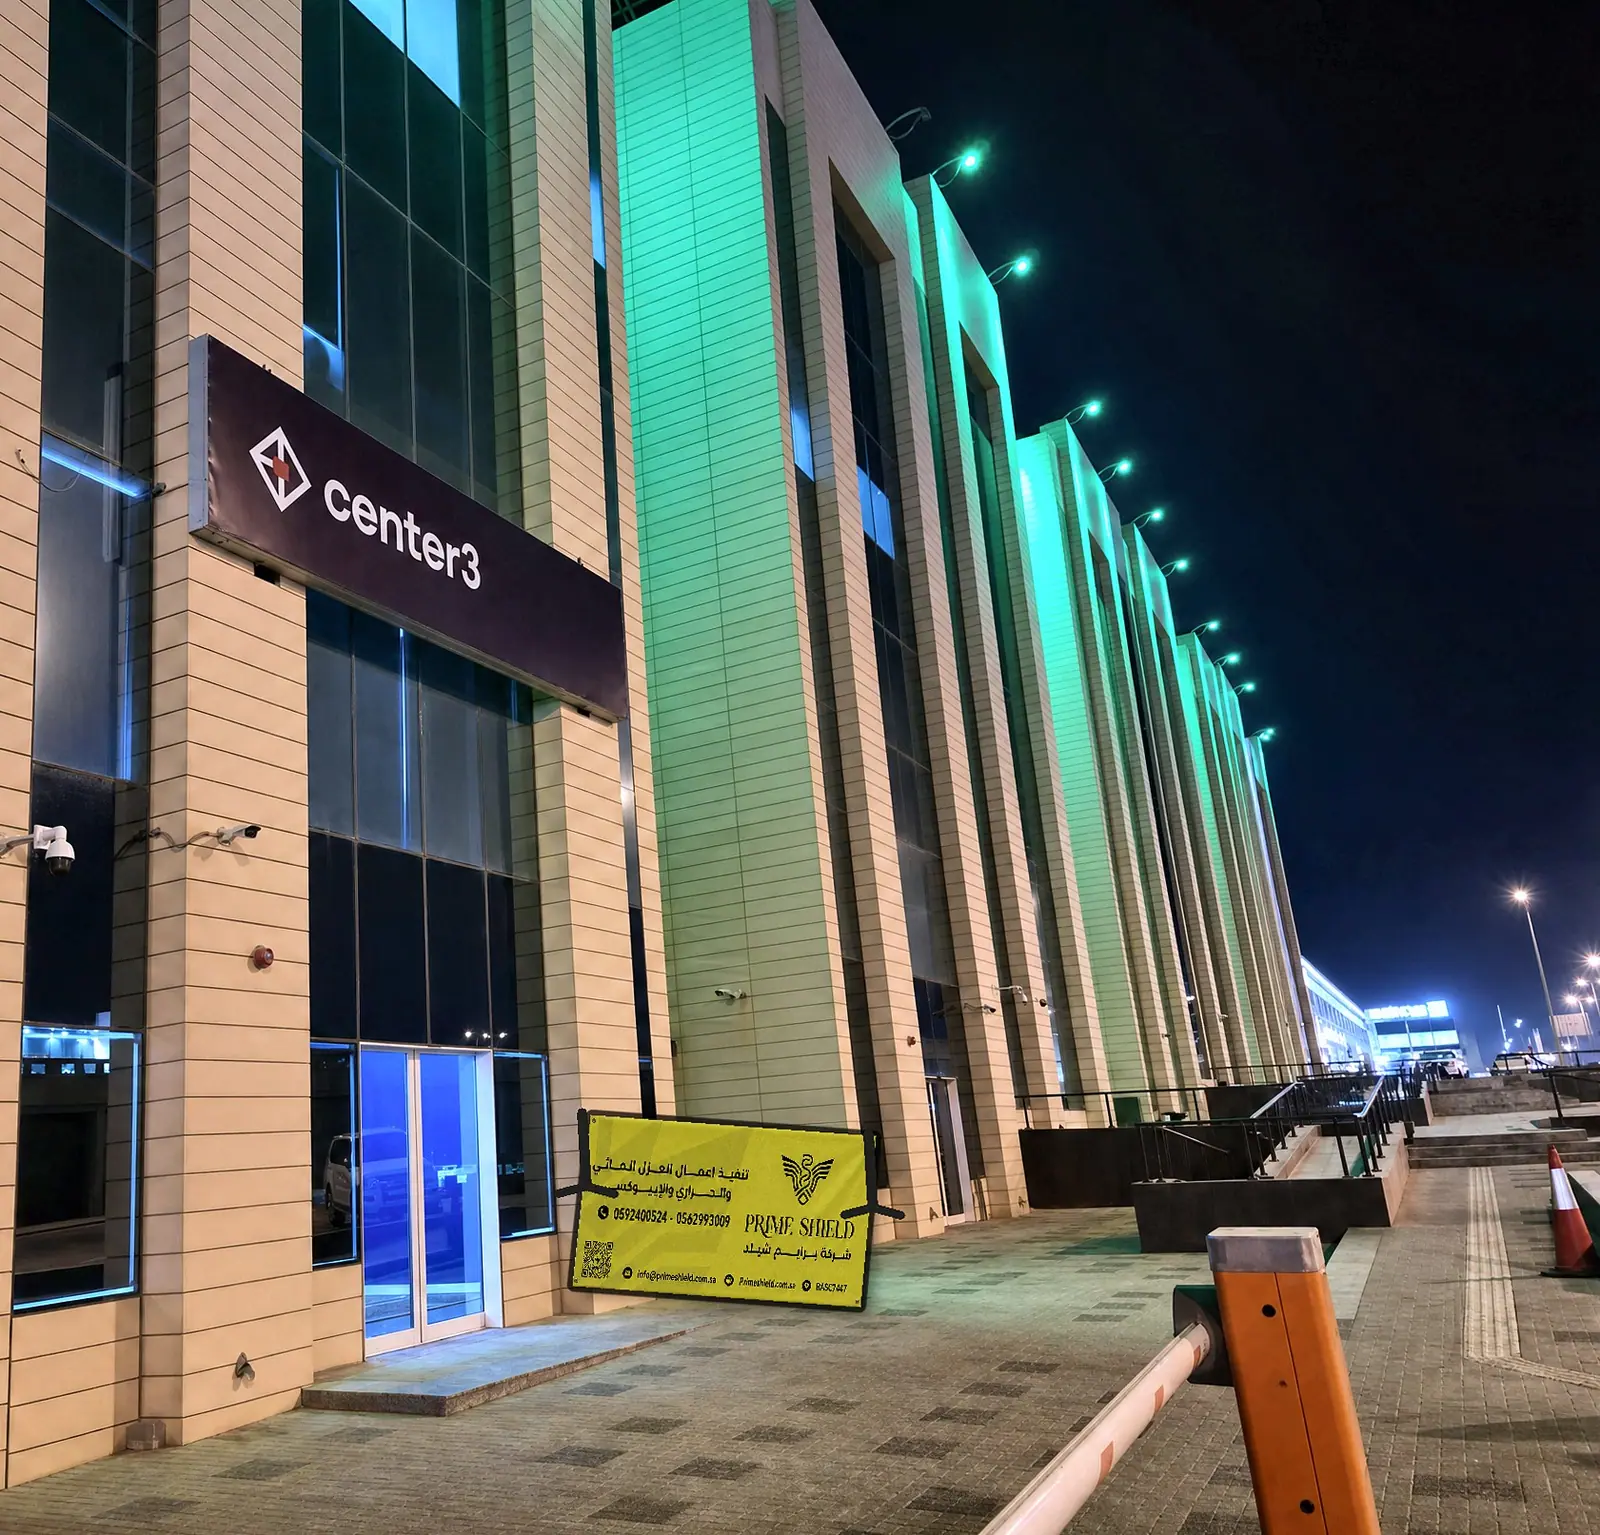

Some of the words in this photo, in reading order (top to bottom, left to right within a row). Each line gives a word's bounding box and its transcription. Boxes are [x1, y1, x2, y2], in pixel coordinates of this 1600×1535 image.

[323, 479, 481, 590] center3
[592, 1156, 637, 1175] المائي
[638, 1160, 674, 1176] العزل
[718, 1167, 750, 1183] تنفيذ
[676, 1185, 732, 1202] والحراري
[613, 1207, 668, 1224] 0592400524
[676, 1211, 731, 1228] 0562993009
[744, 1213, 794, 1239] PRIME
[799, 1217, 855, 1240] SHIELD
[743, 1242, 772, 1258] شيلد
[773, 1246, 818, 1261] برايم
[820, 1247, 852, 1263] شركة
[636, 1269, 717, 1285] info@primeshield.com.sa
